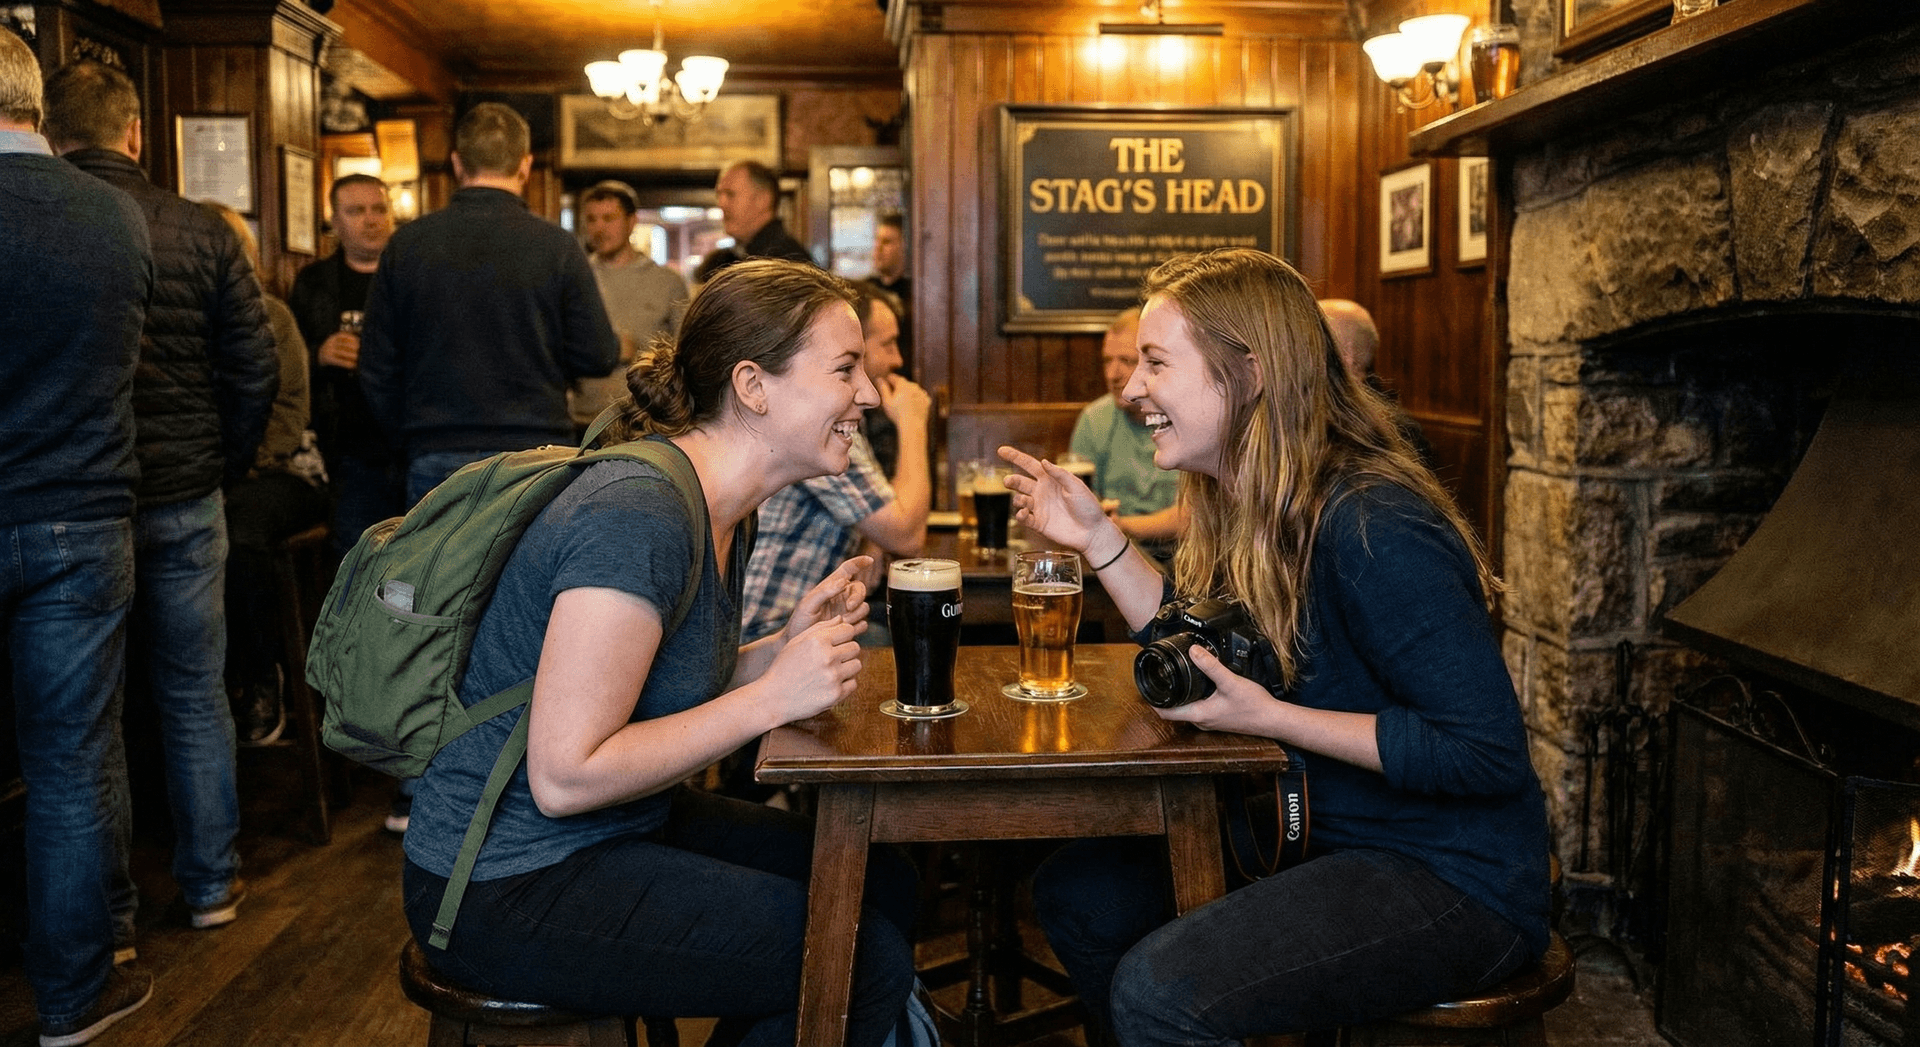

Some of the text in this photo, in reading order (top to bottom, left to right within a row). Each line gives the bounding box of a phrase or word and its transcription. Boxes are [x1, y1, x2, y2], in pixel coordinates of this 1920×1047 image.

[1110, 138, 1185, 173] THE
[1030, 178, 1266, 213] STAG'S HEAD
[1287, 793, 1300, 841] Canon
